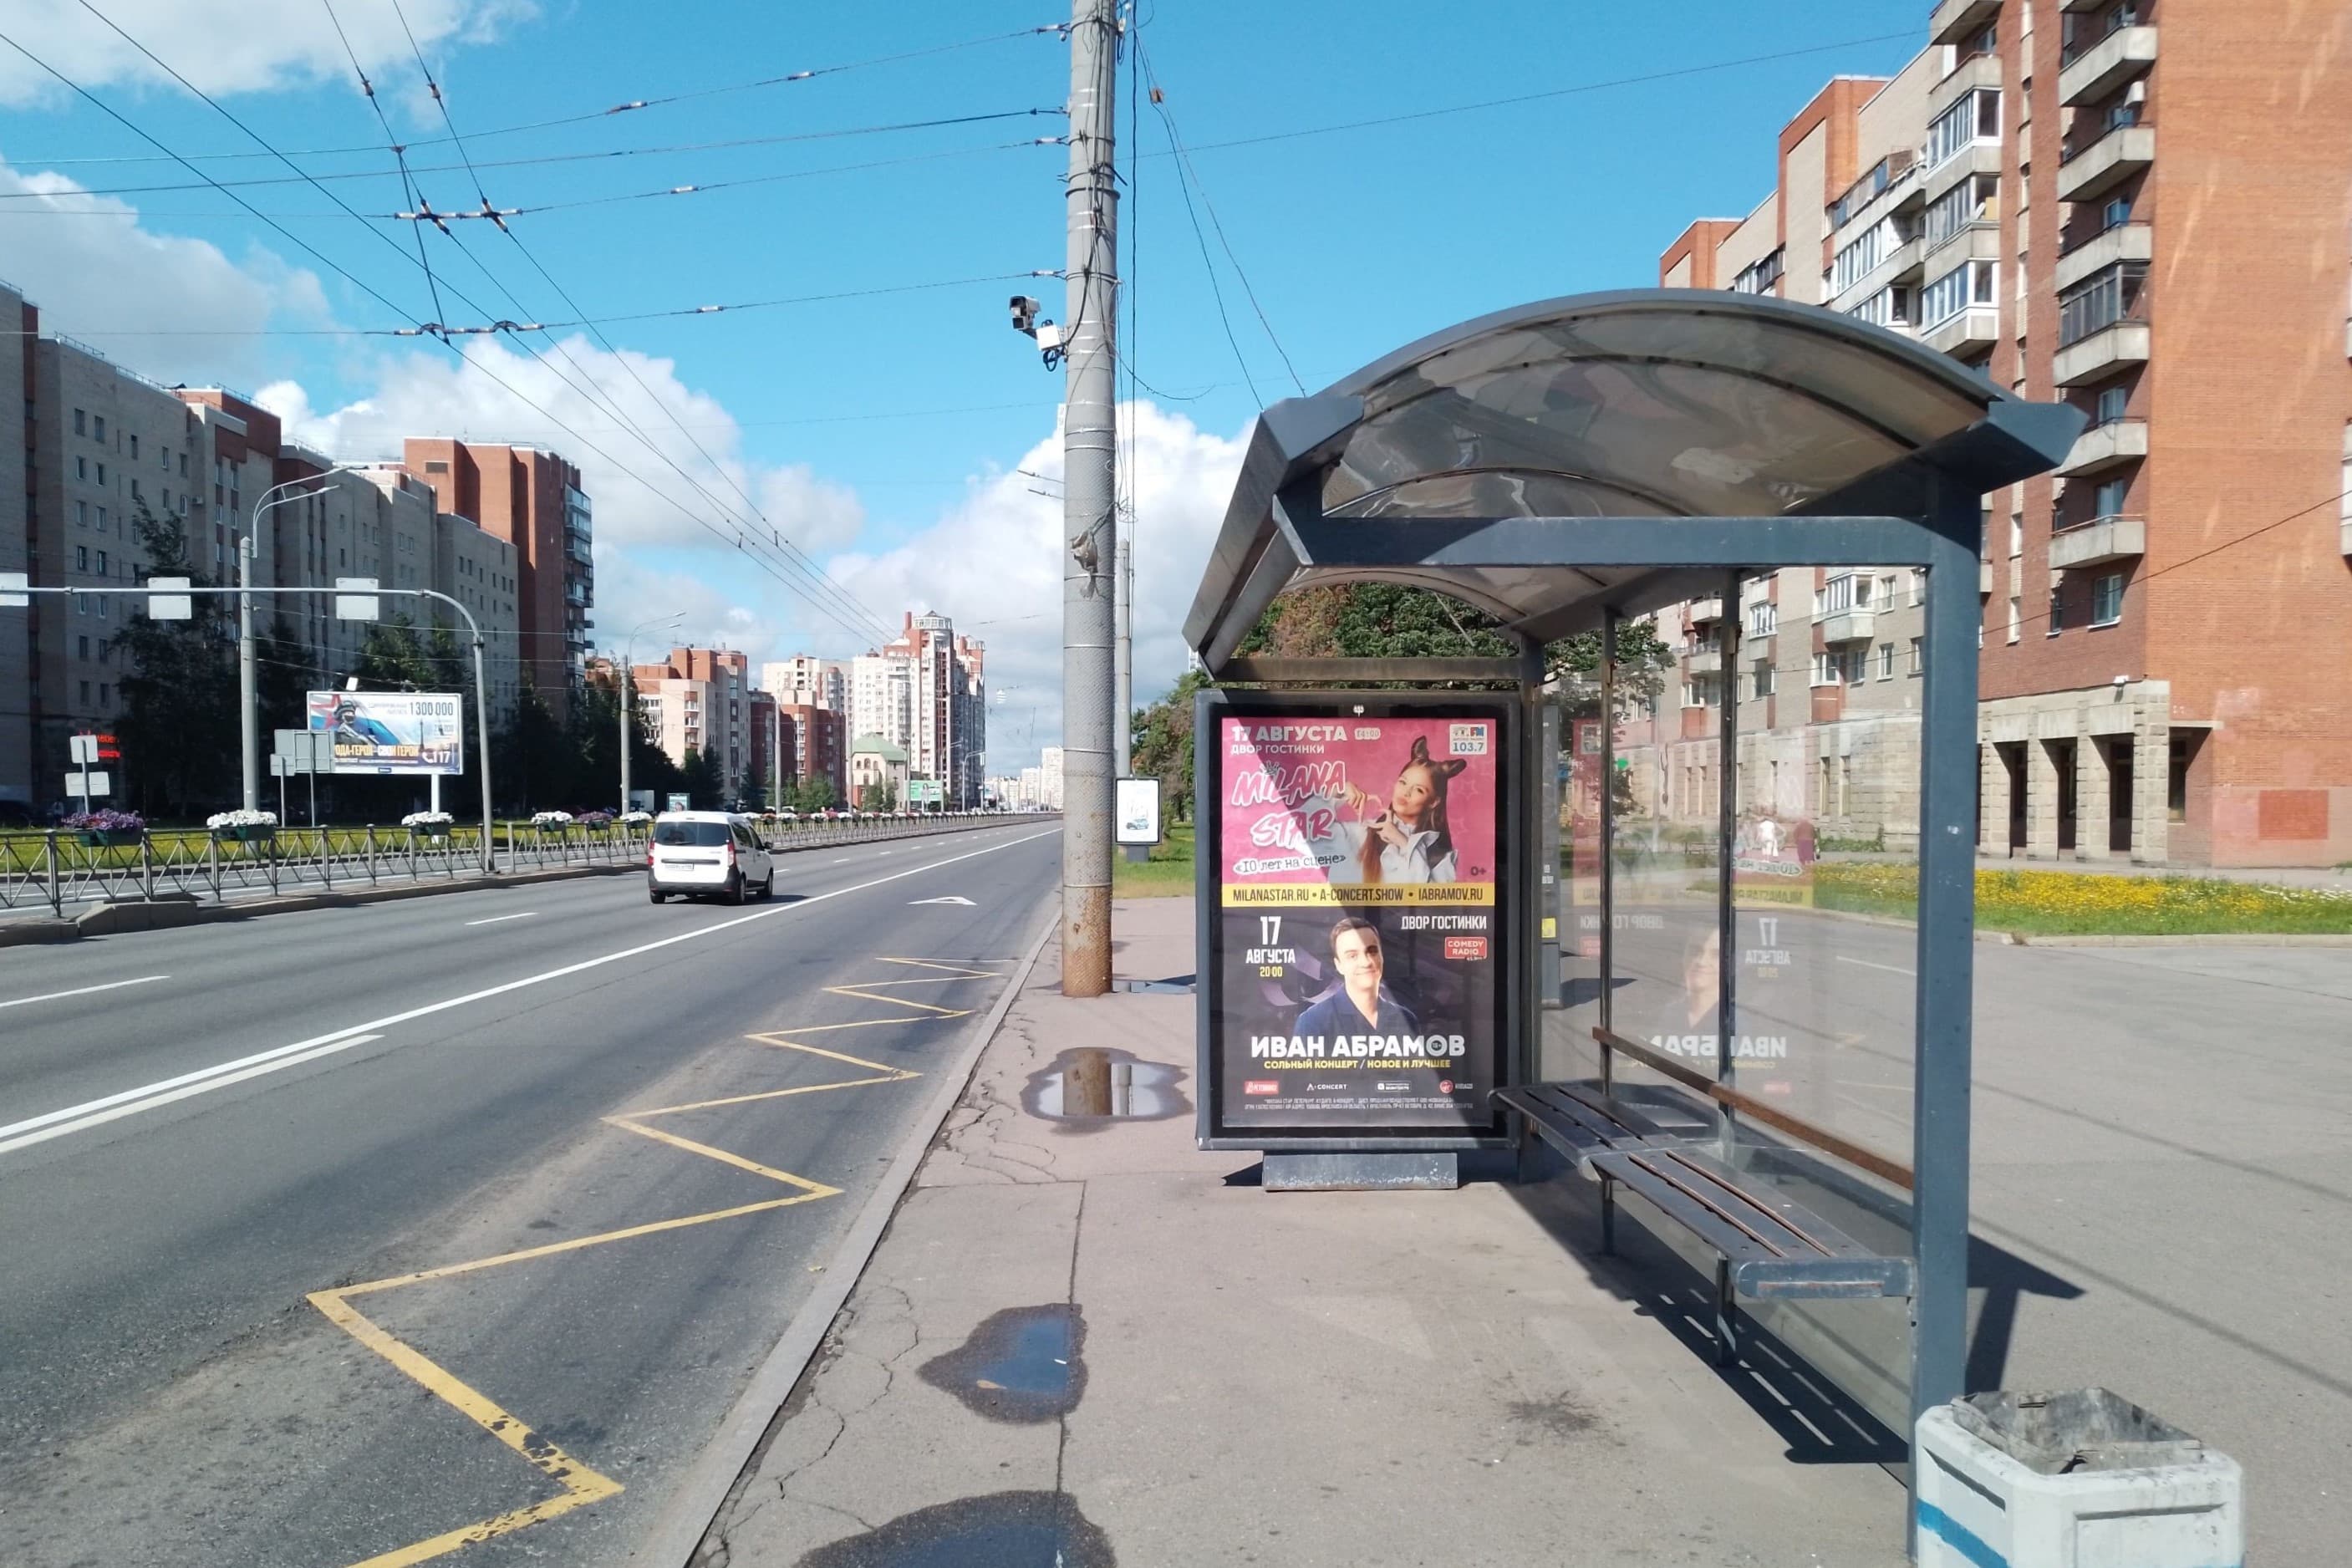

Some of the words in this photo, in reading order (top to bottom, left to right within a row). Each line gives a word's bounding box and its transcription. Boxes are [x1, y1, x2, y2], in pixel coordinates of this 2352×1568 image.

[1230, 725, 1252, 741] 17
[1255, 725, 1348, 741] АВГУСТА
[1230, 744, 1262, 755] ДВОР
[1265, 744, 1326, 754] ГОСТИНКИ
[1453, 742, 1484, 752] 103.7
[434, 751, 451, 764] 117
[1231, 761, 1347, 807] MILANA
[1250, 808, 1336, 848] STAR
[1260, 861, 1282, 871] лет
[1285, 859, 1301, 868] на
[1302, 853, 1347, 868] сцене»
[1470, 866, 1487, 876] 0+
[1233, 888, 1310, 902] MILANASTAR.RU
[1320, 888, 1404, 902] A-CONCERT.SHOW
[1418, 888, 1484, 901] IABRAMOV.RU
[1400, 915, 1430, 930] ДВОР
[1432, 915, 1487, 930] ГОСТИНКИ
[1260, 916, 1282, 945] 17
[1245, 949, 1296, 964] АВГУСТА
[1251, 1036, 1325, 1058] ИВАН
[1331, 1035, 1465, 1058] АБРАМОВ
[1264, 1058, 1313, 1069] СОЛЬНЫЙ
[1314, 1059, 1358, 1070] КОНЦЕРТ
[1367, 1059, 1402, 1069] НОВОЕ
[1403, 1059, 1409, 1068] И
[1410, 1059, 1451, 1069] ЛУЧШЕЕ
